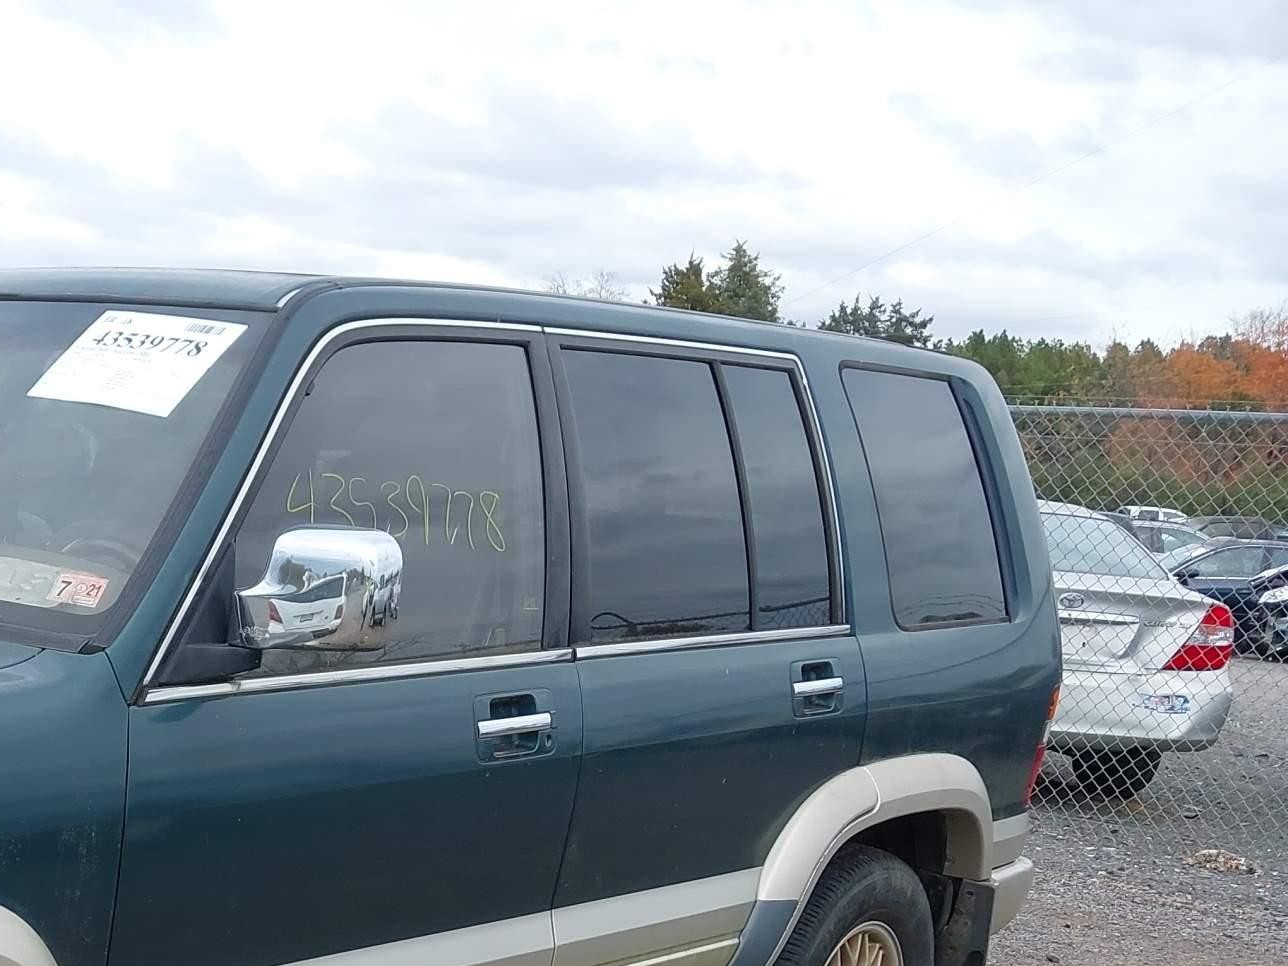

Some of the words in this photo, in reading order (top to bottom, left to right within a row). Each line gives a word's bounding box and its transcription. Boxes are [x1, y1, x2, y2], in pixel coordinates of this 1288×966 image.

[92, 329, 209, 358] 43539778
[286, 467, 507, 552] 43539778
[56, 579, 73, 597] 7
[86, 583, 103, 597] 21
